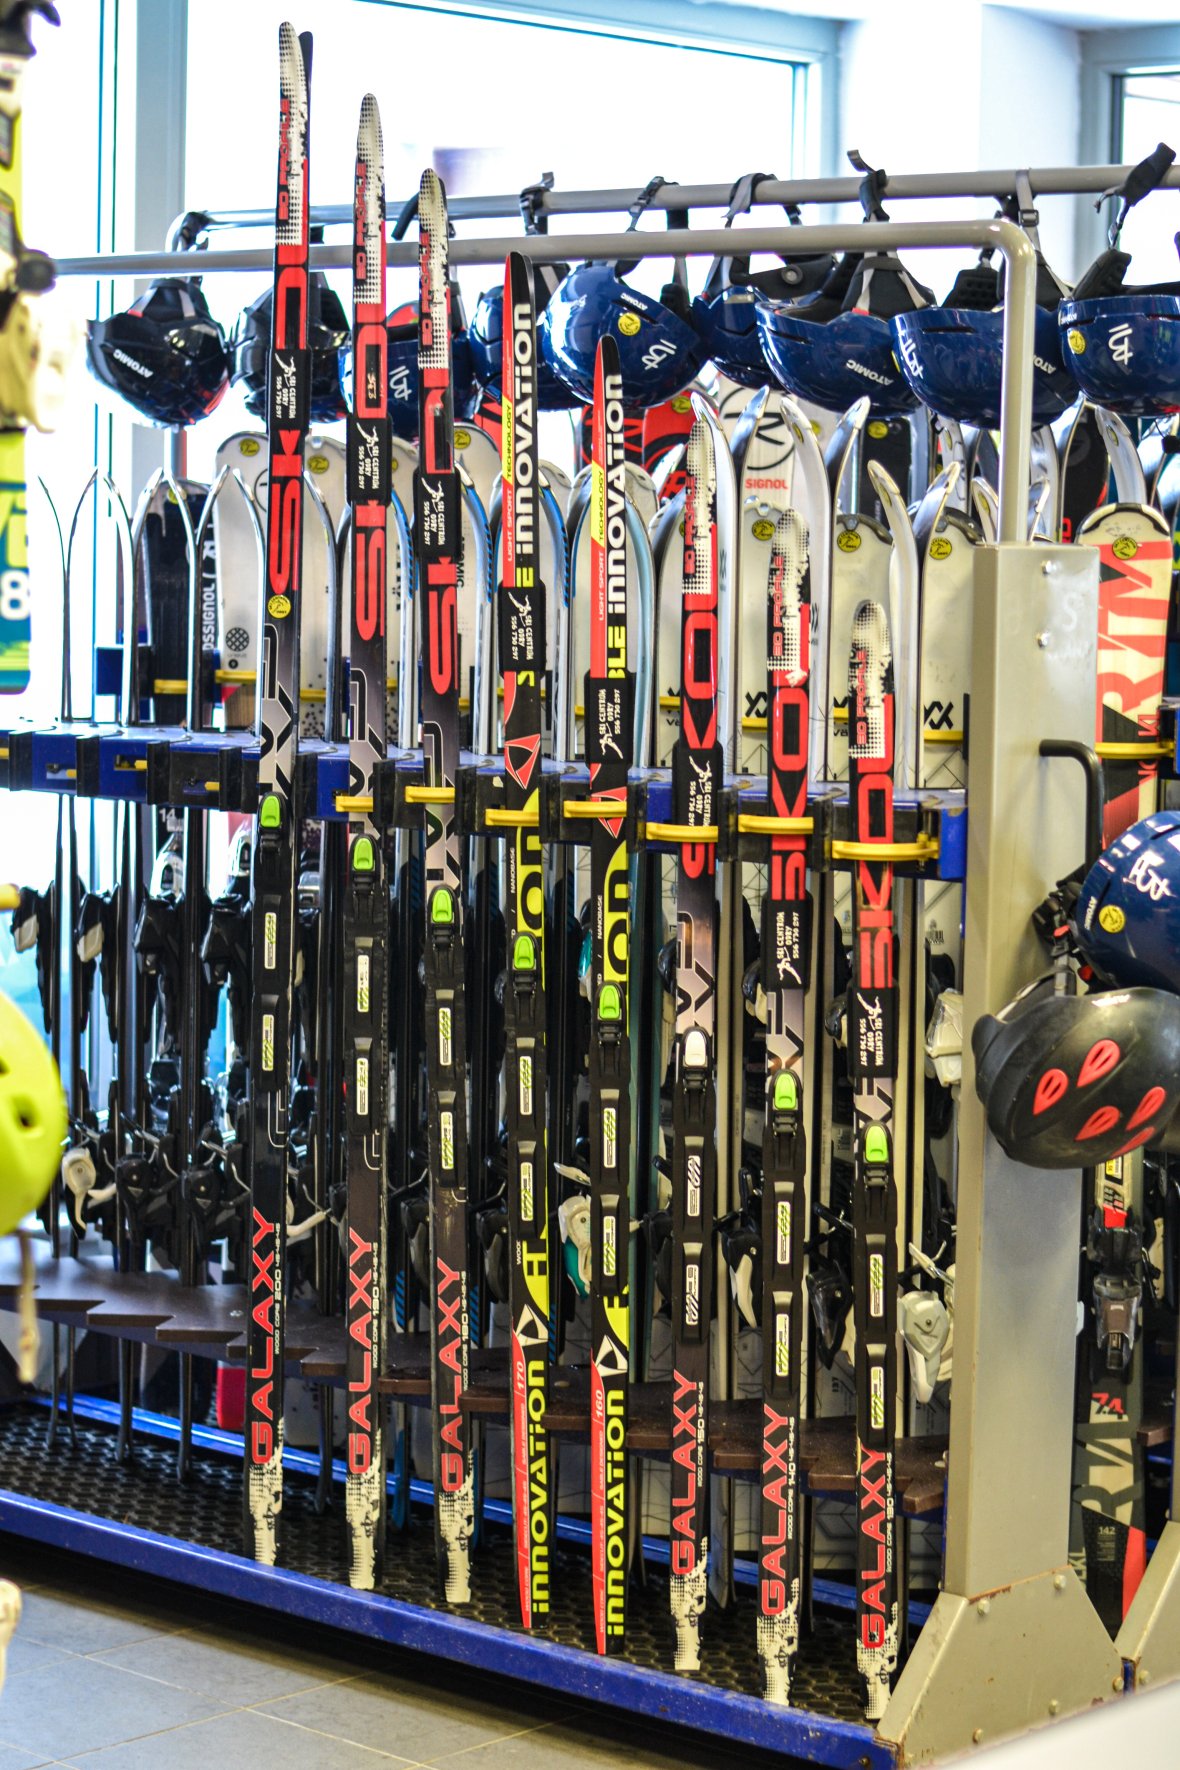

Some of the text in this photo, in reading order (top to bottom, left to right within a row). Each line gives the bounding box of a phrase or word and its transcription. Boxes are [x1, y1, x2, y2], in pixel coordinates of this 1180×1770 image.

[620, 292, 648, 311] ATOMIC
[112, 348, 154, 379] ATOMIC
[845, 359, 893, 386] ATOMIC
[505, 404, 514, 480] TECHNOLOGY
[597, 471, 606, 542] TECHNOLOGY
[744, 478, 789, 490] SIGNOL
[202, 583, 215, 651] OSSIGNOL
[770, 603, 808, 900] SKOL
[856, 692, 893, 988] SKOL
[1084, 896, 1098, 930] ATOMIC
[251, 1206, 274, 1464] GALAXY
[349, 1226, 371, 1474] GALAXY
[437, 1258, 463, 1493] GALAXY
[516, 1361, 524, 1390] 170
[595, 1389, 603, 1418] 160
[1091, 1392, 1125, 1420] 7.4
[672, 1368, 697, 1575] GALAXY
[761, 1402, 788, 1616] GALAXY
[1097, 1526, 1116, 1536] 142
[860, 1442, 886, 1649] GALAXY
